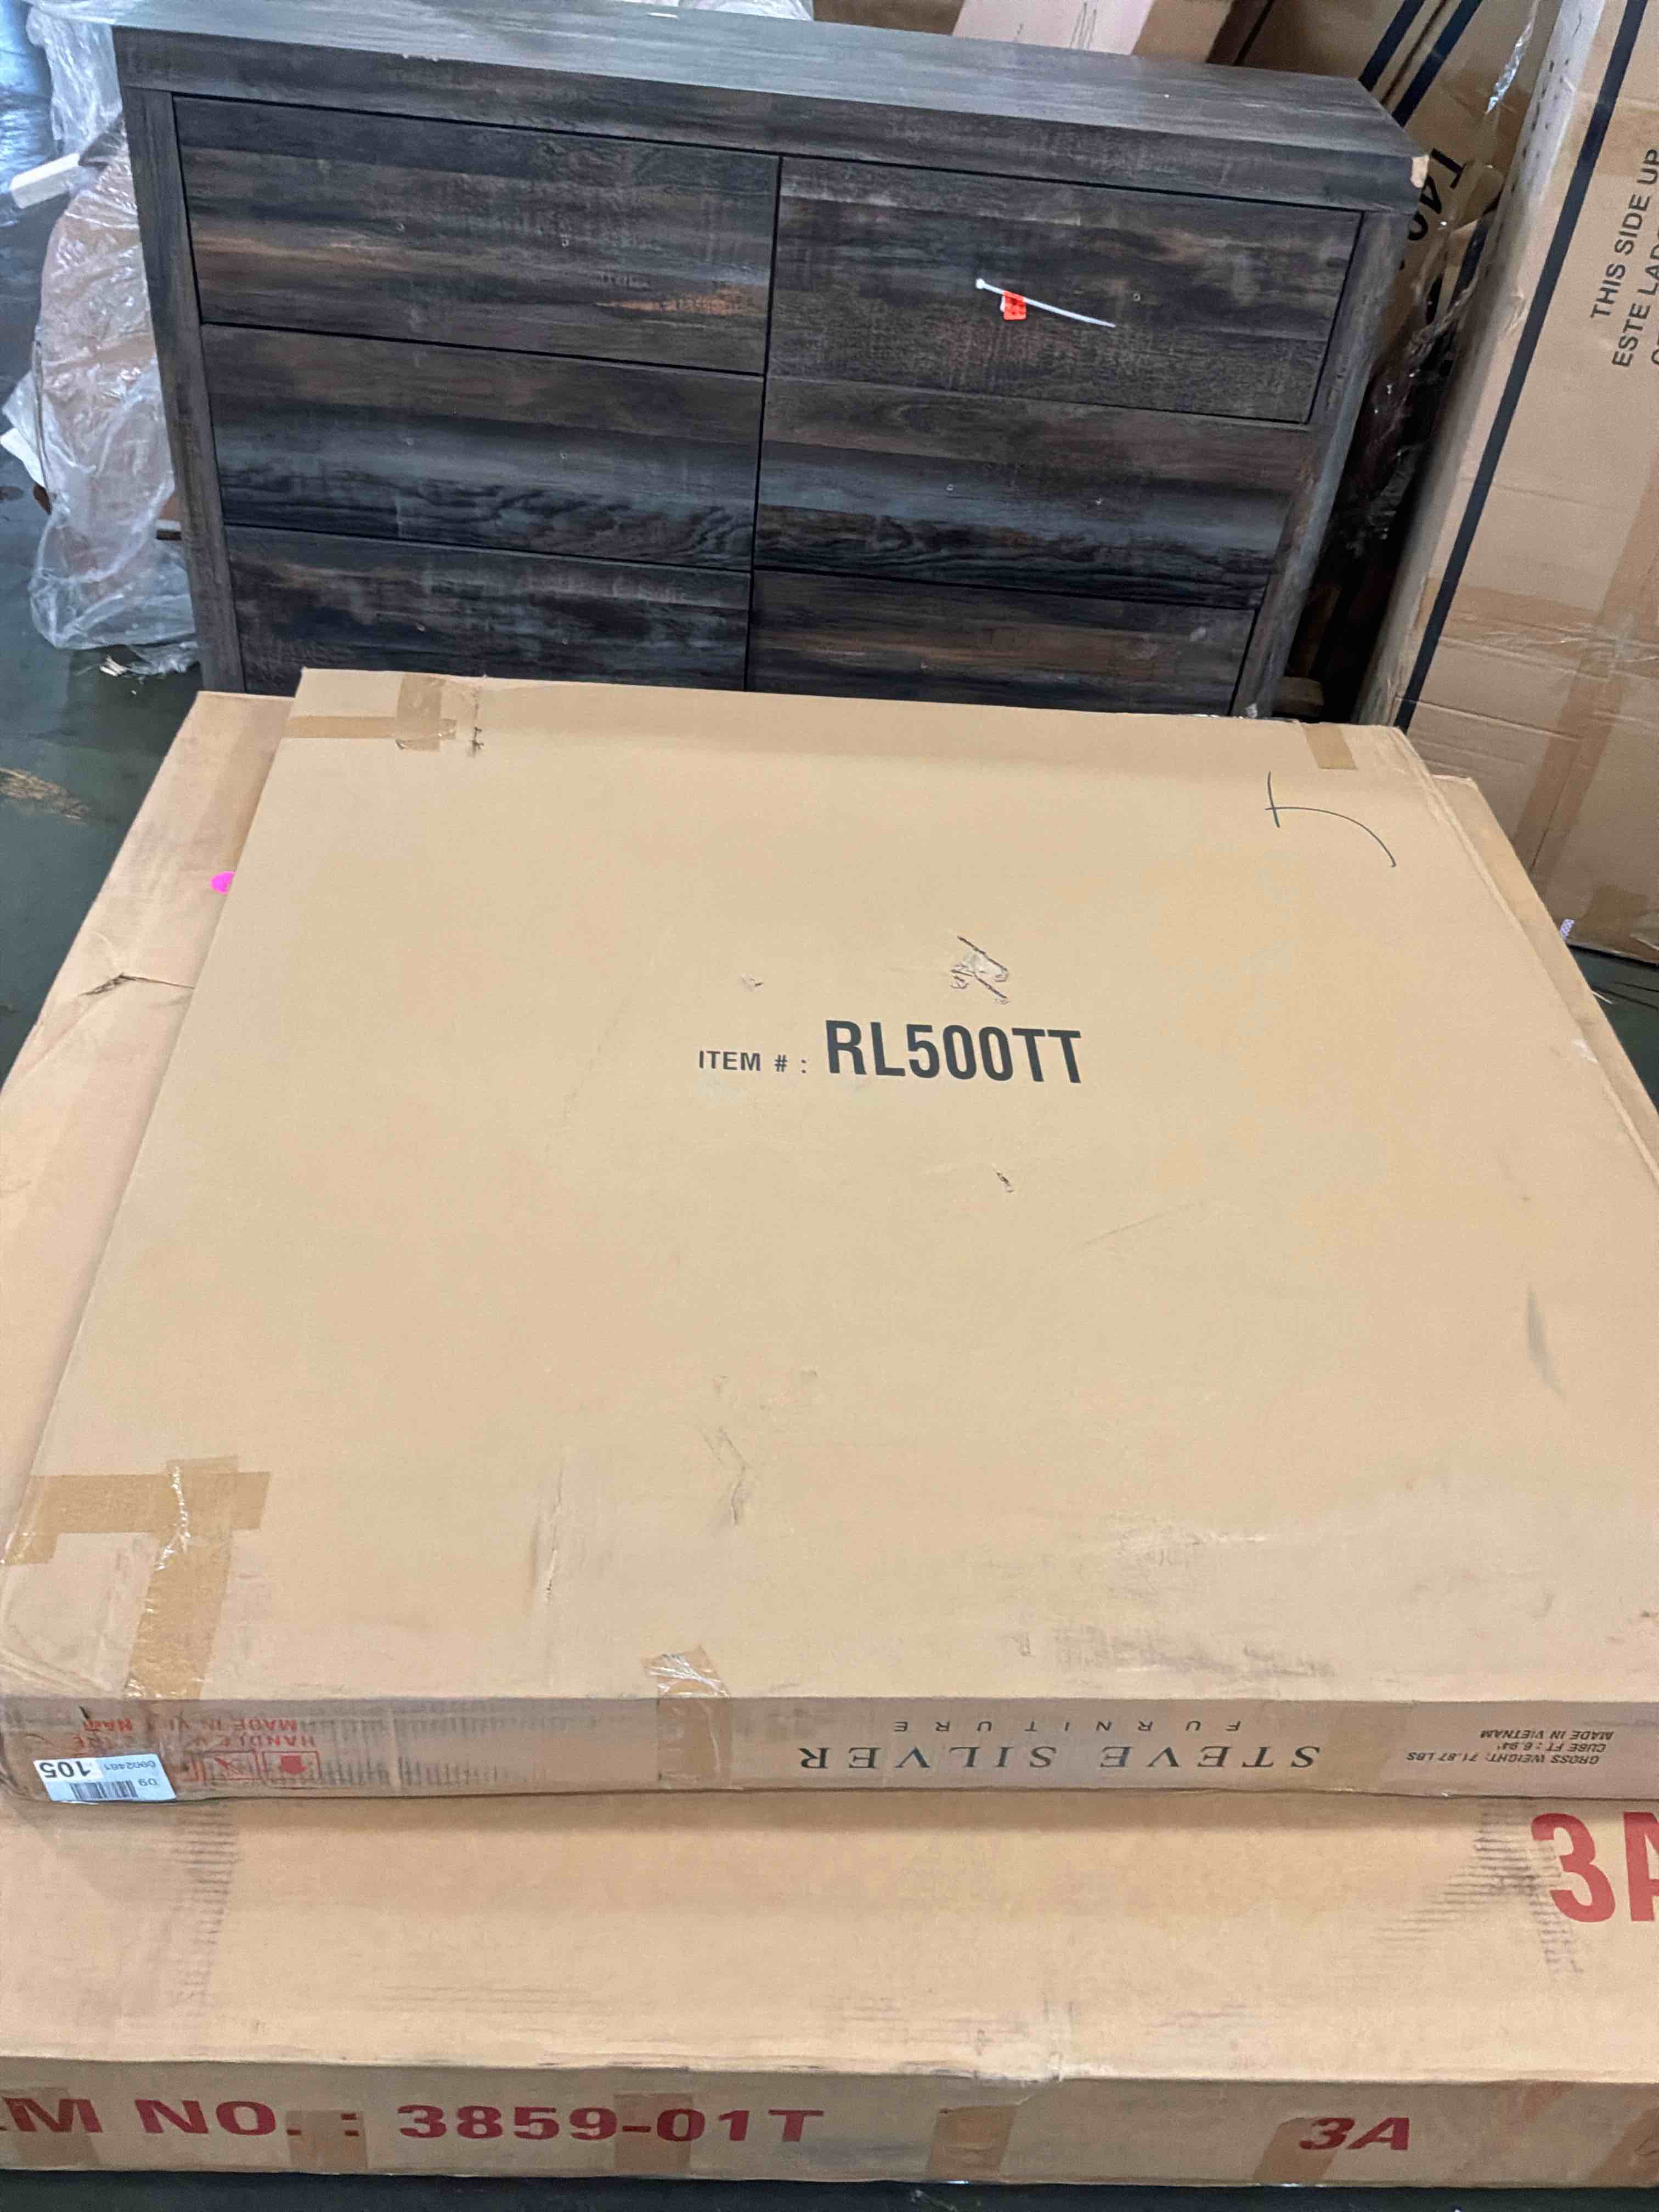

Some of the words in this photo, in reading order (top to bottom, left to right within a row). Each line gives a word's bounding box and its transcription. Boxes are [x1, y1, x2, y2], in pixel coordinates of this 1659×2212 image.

[1590, 263, 1626, 318] THIS
[1614, 193, 1651, 256] SIDE
[1637, 149, 1659, 185] UP
[1612, 303, 1651, 367] ESTE
[698, 1049, 761, 1072] ITEM
[825, 1019, 1082, 1084] RL500TT
[895, 1720, 1242, 1733] FURNITURE
[1480, 1729, 1544, 1739] VIETNAM
[1549, 1730, 1566, 1740] IN
[1572, 1730, 1615, 1741] MADE
[1405, 1751, 1434, 1761] LBS
[1545, 1742, 1565, 1752] FT
[799, 1746, 1057, 1769] SILVER
[1101, 1745, 1321, 1768] STEVE
[1550, 1754, 1600, 1765] GROSS
[39, 1760, 91, 1778] 105
[0, 2097, 103, 2133] M
[134, 2099, 302, 2136] NO.
[397, 2104, 824, 2143] 3859-01T
[1299, 2117, 1410, 2151] 3A
